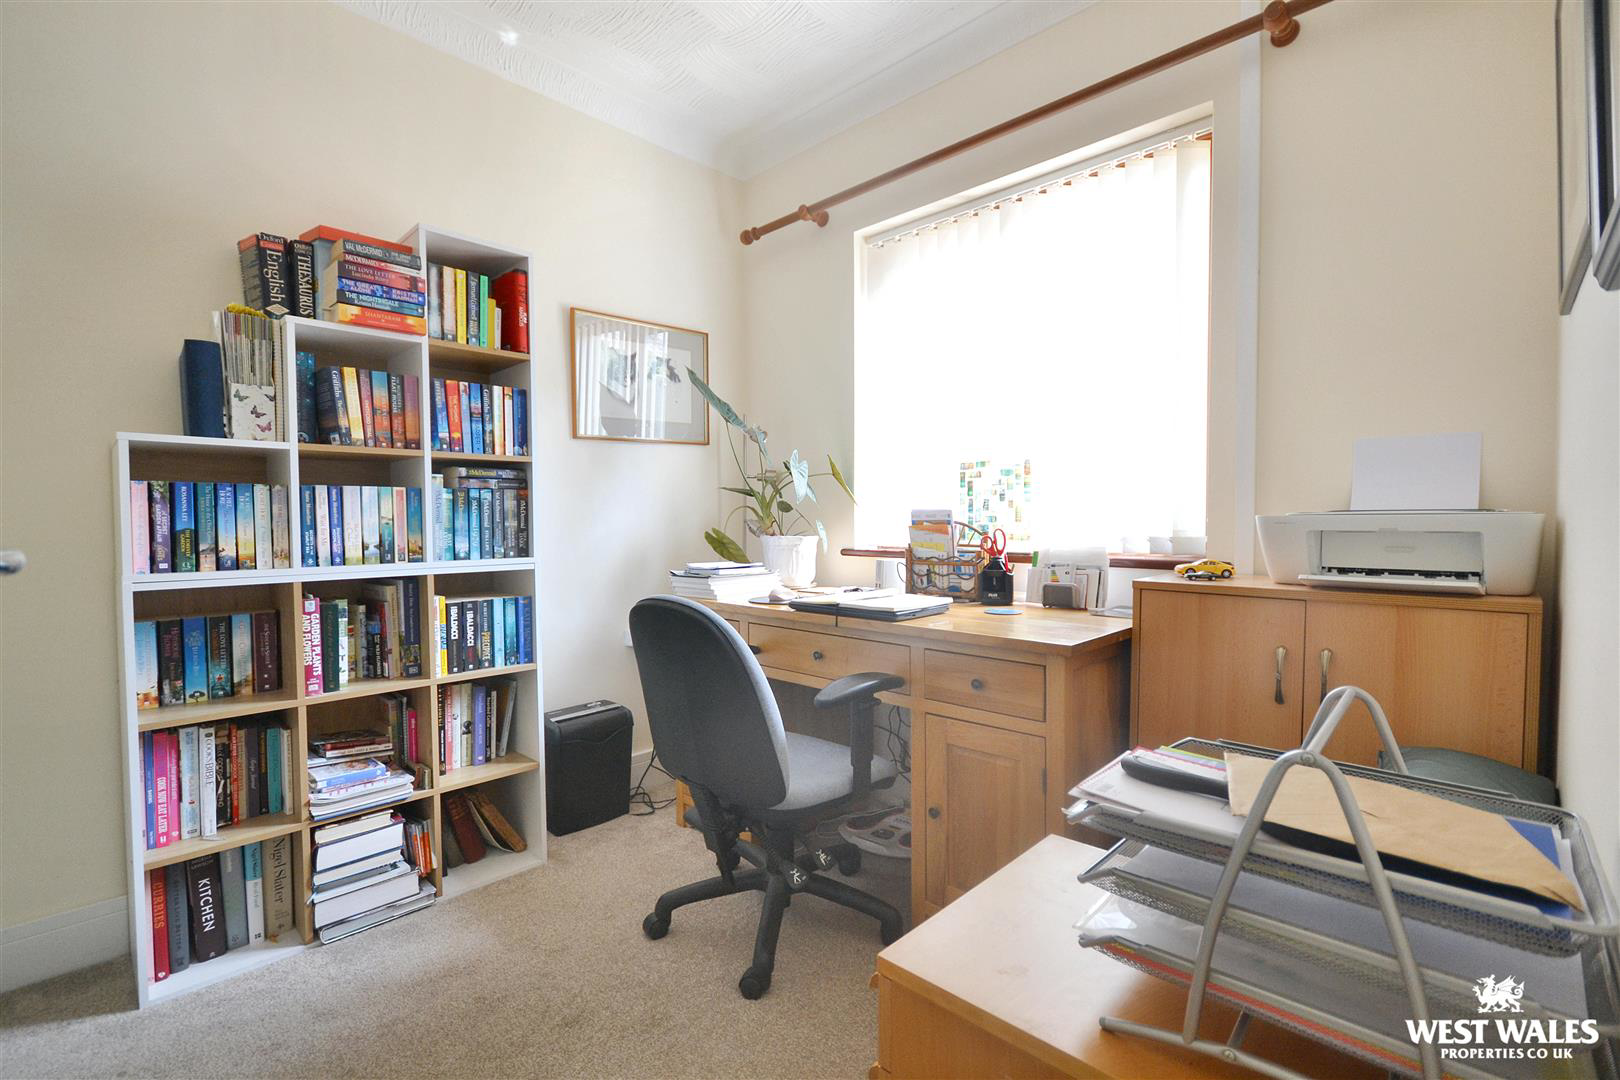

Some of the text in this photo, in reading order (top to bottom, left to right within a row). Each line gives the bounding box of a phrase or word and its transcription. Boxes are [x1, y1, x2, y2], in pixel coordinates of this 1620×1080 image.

[263, 249, 286, 302] English
[297, 255, 314, 318] THESAURUS
[302, 615, 312, 665] AND FLOWERS
[311, 613, 321, 676] GARDEN PLANTS
[481, 632, 490, 660] PRECIPICE
[158, 815, 167, 833] LATER
[271, 837, 289, 904] Nigel Slater
[152, 882, 165, 929] CURRIES
[198, 878, 215, 932] KITCHEN
